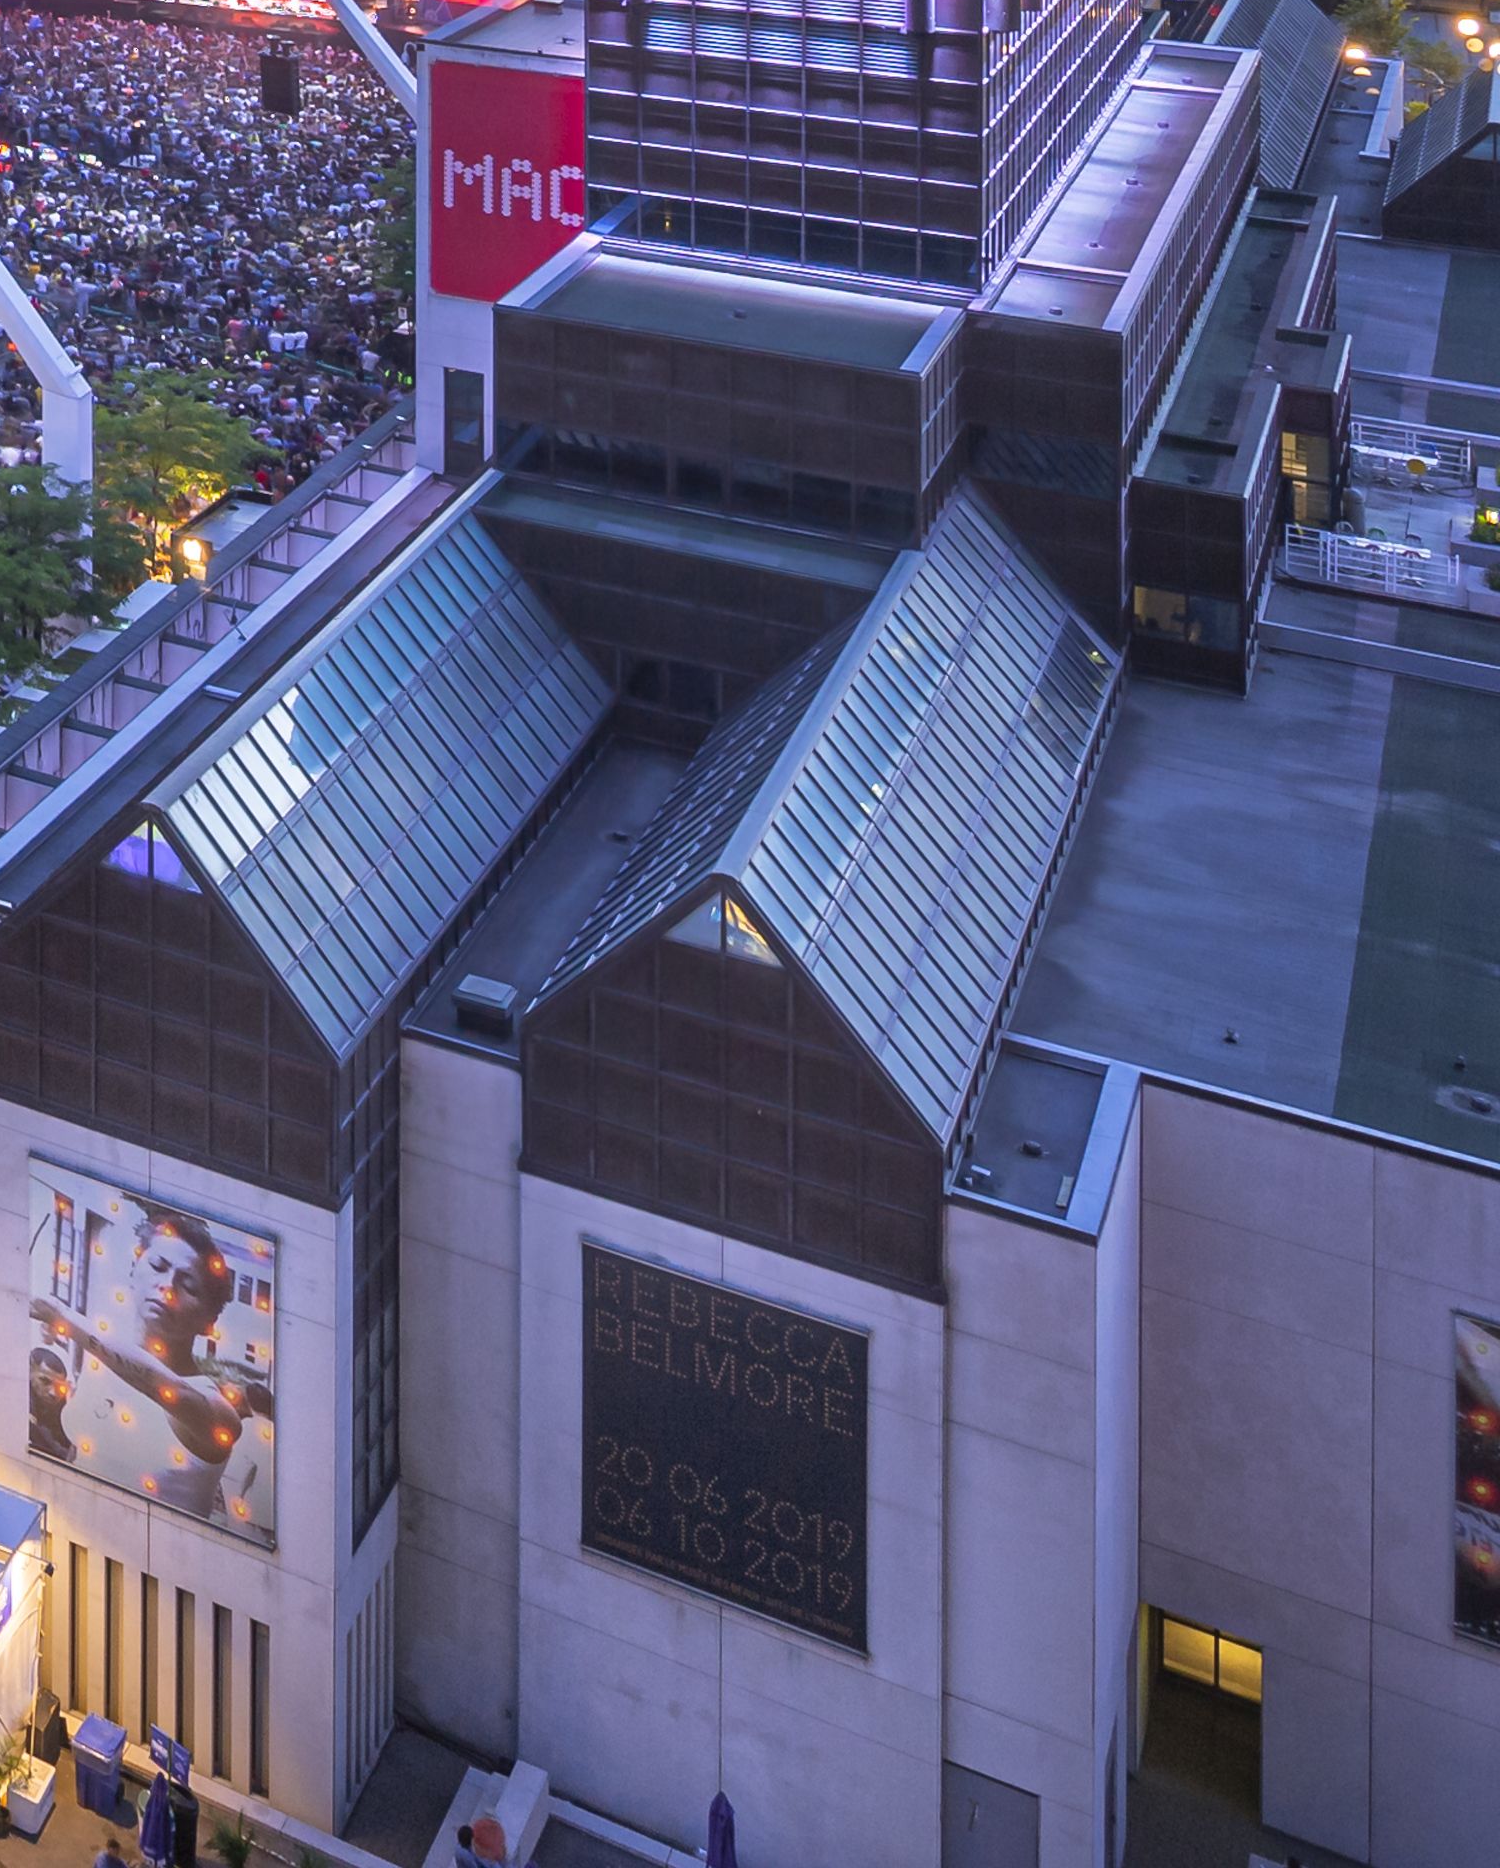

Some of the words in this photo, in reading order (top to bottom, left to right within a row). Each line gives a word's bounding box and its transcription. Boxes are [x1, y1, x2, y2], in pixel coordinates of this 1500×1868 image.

[443, 149, 585, 227] MAC
[594, 1256, 854, 1385] REBECCA
[594, 1307, 854, 1437] BELMORE
[594, 1485, 651, 1536] 06
[672, 1513, 726, 1563] 10
[744, 1538, 853, 1611] 2019
[596, 1436, 653, 1486] 20
[668, 1463, 728, 1516] 06
[745, 1489, 853, 1560] 2019
